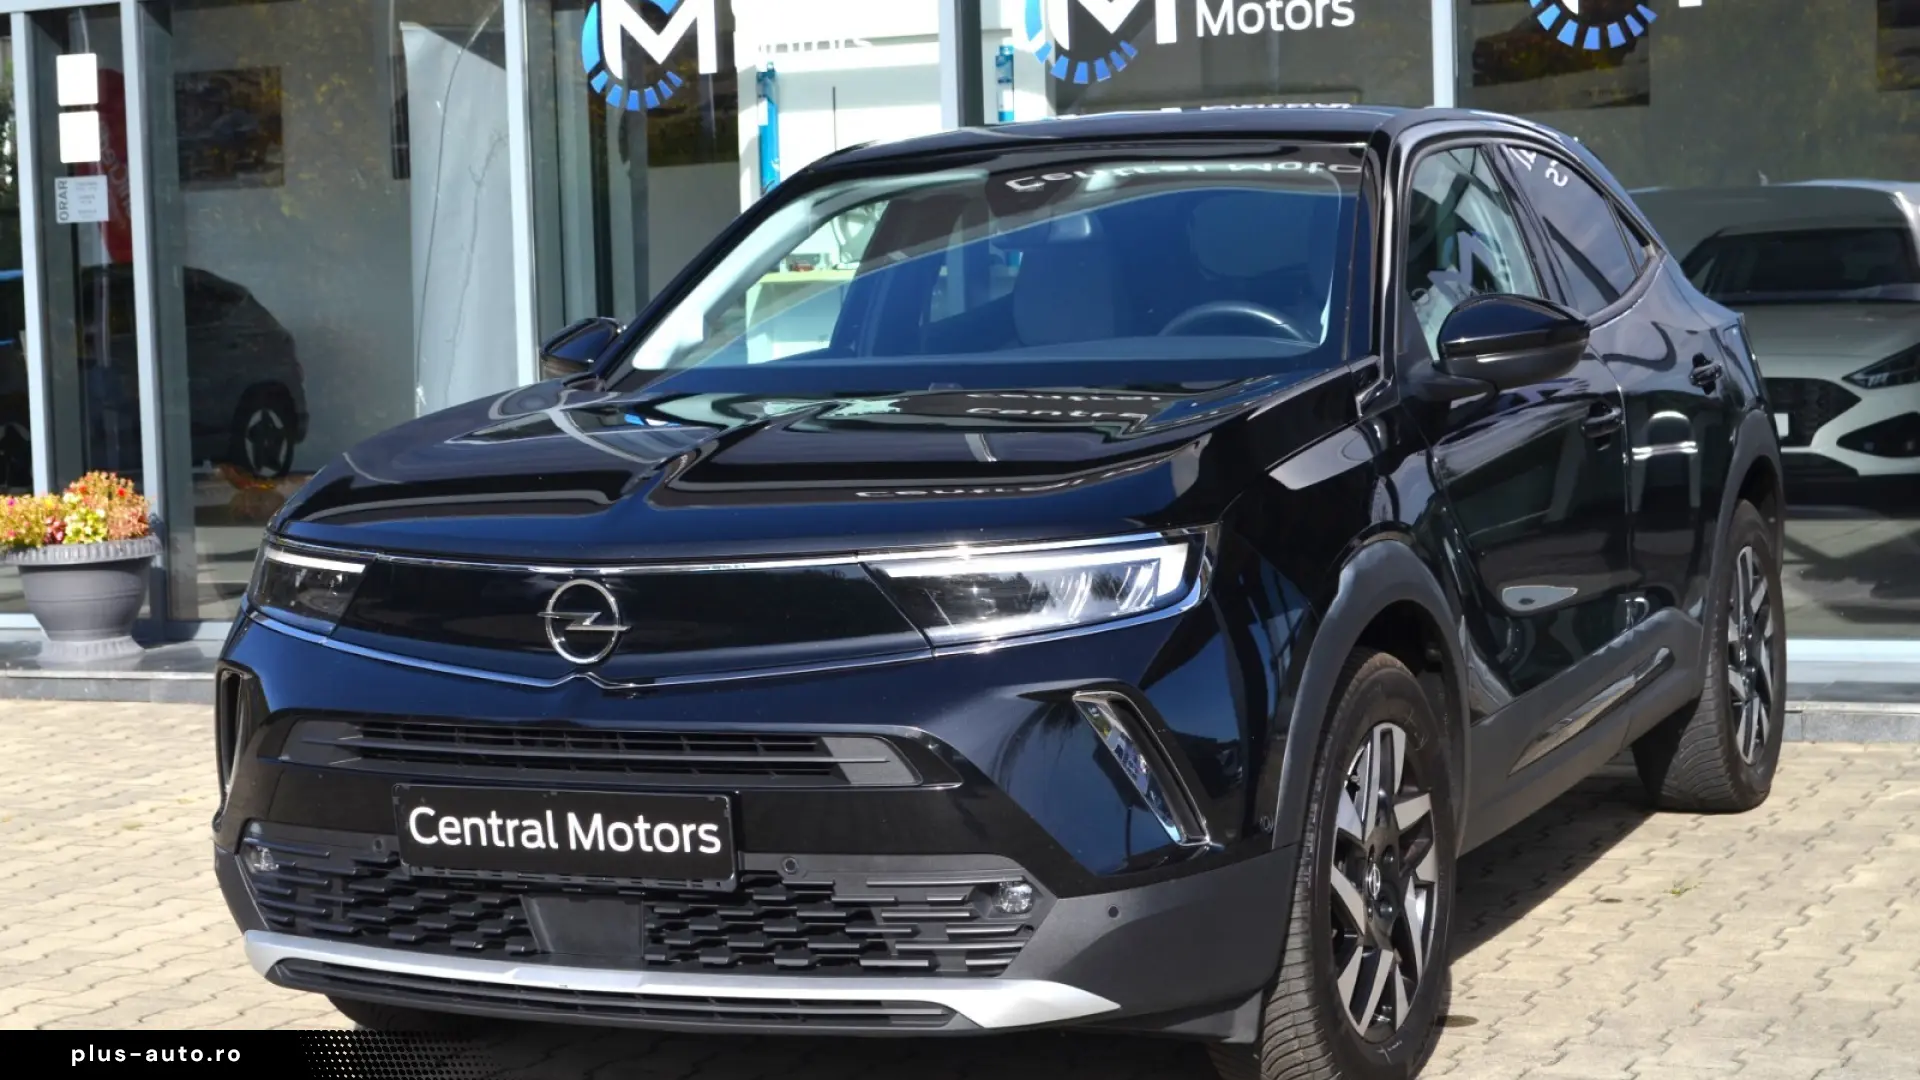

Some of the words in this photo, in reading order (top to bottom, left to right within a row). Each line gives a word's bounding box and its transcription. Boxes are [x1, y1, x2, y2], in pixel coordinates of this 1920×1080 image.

[1196, 0, 1356, 38] Motors
[58, 180, 69, 221] ORAR
[408, 806, 559, 850] Central
[567, 811, 722, 854] Motors
